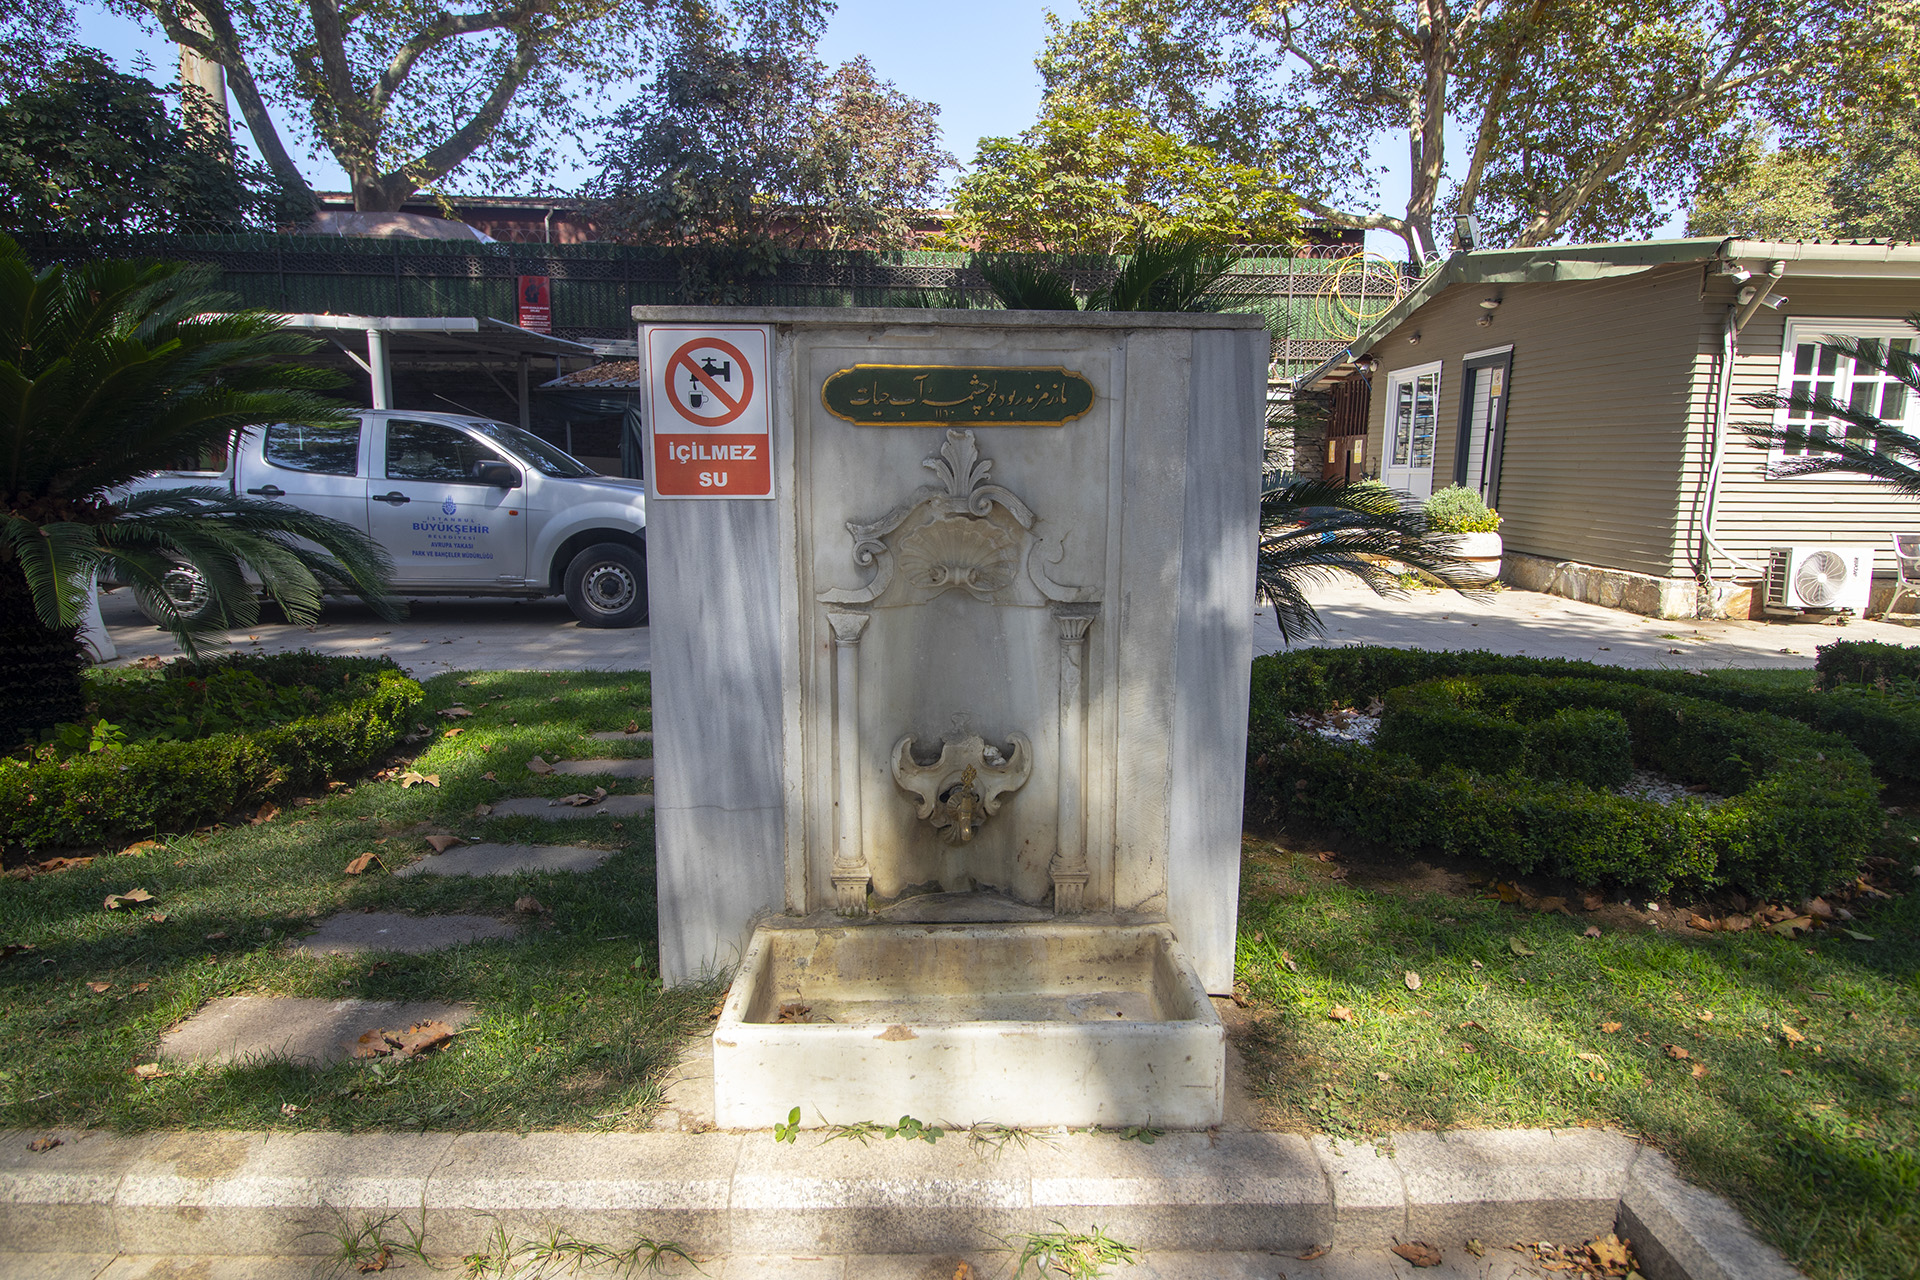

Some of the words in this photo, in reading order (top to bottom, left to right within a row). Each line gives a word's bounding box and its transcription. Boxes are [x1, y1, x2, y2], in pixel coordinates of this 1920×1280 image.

[669, 441, 757, 465] İÇİLMEZ
[699, 471, 728, 488] SU
[412, 520, 489, 534] BÜYÜKŞEHİR
